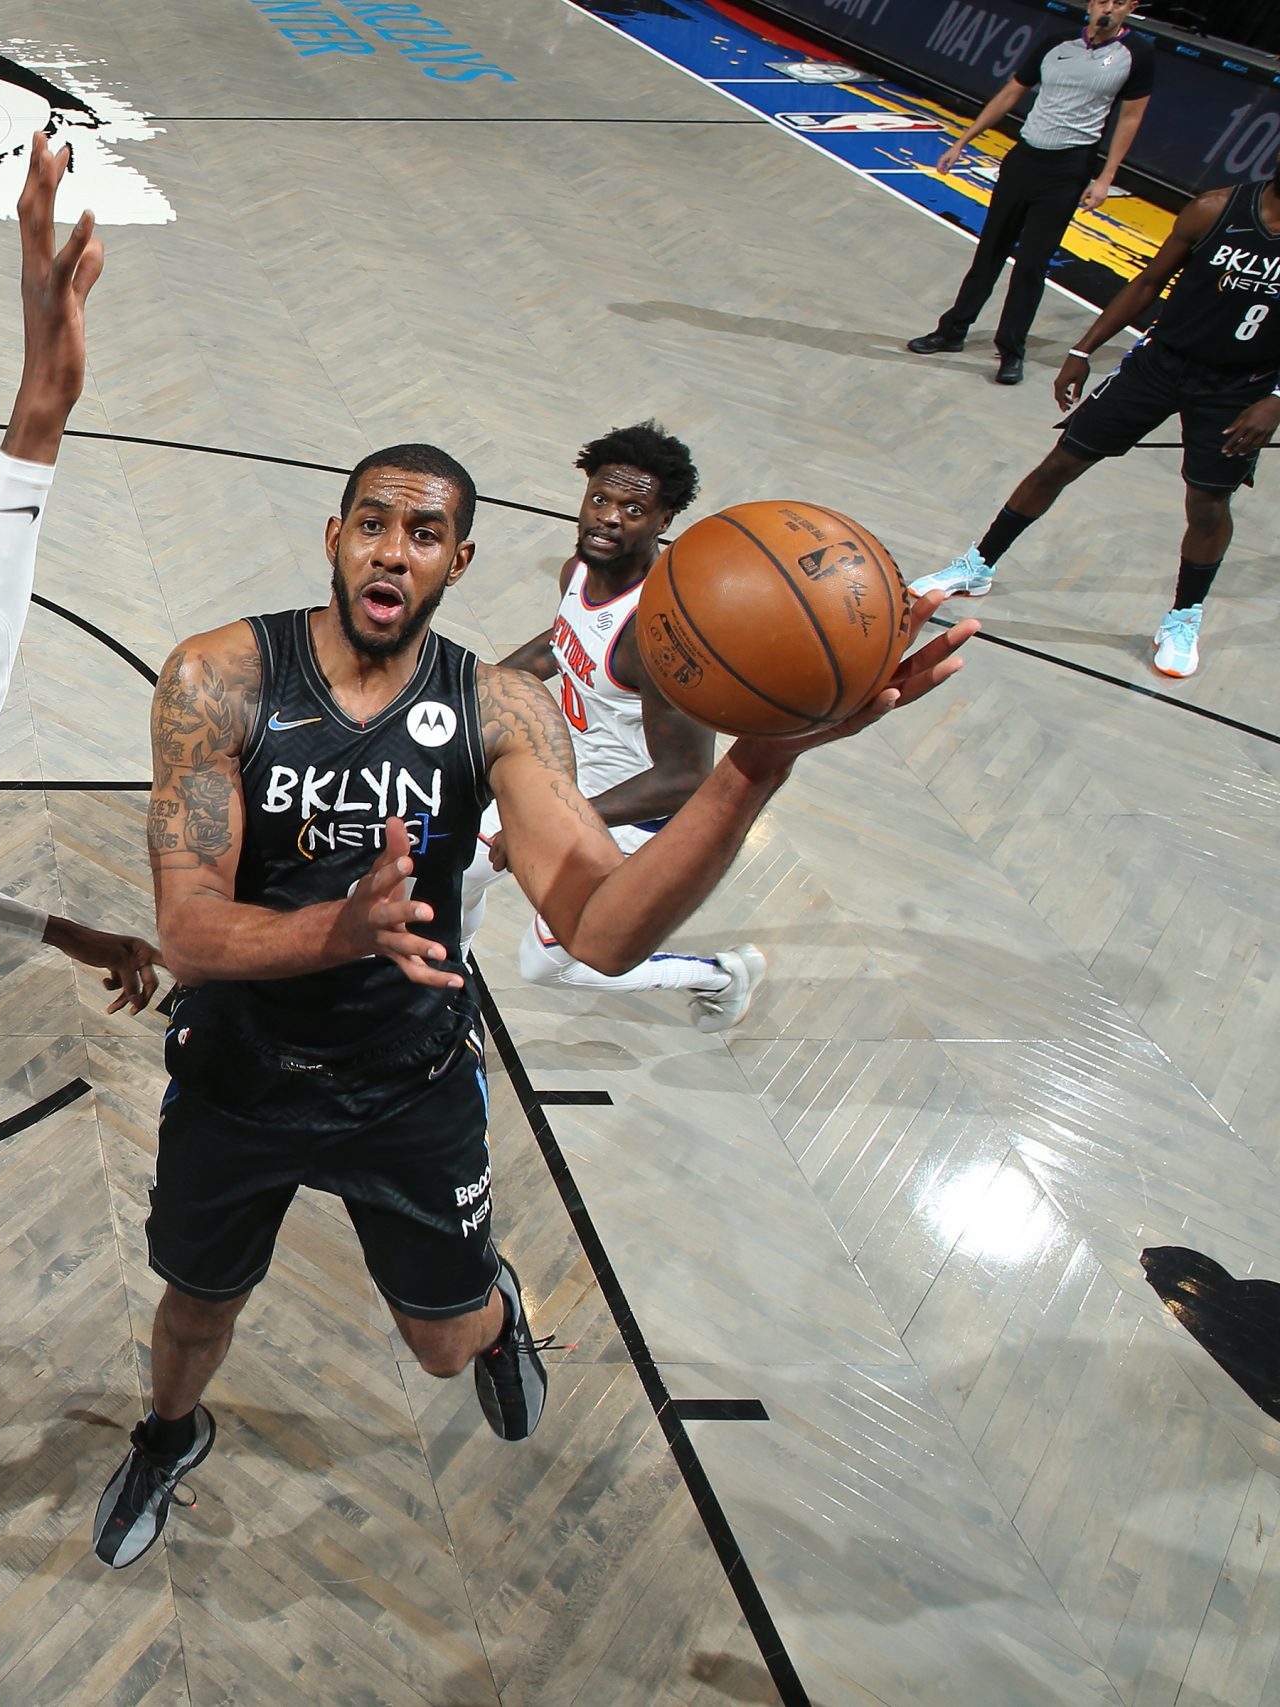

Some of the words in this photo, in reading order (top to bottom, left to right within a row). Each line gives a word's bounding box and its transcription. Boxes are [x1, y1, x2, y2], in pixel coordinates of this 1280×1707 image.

[336, 0, 519, 82] RCLAYS
[926, 2, 1009, 67] MAY
[1222, 276, 1279, 295] NETS
[1235, 304, 1270, 341] 8
[560, 671, 588, 733] 0
[261, 760, 442, 819] BKLYN
